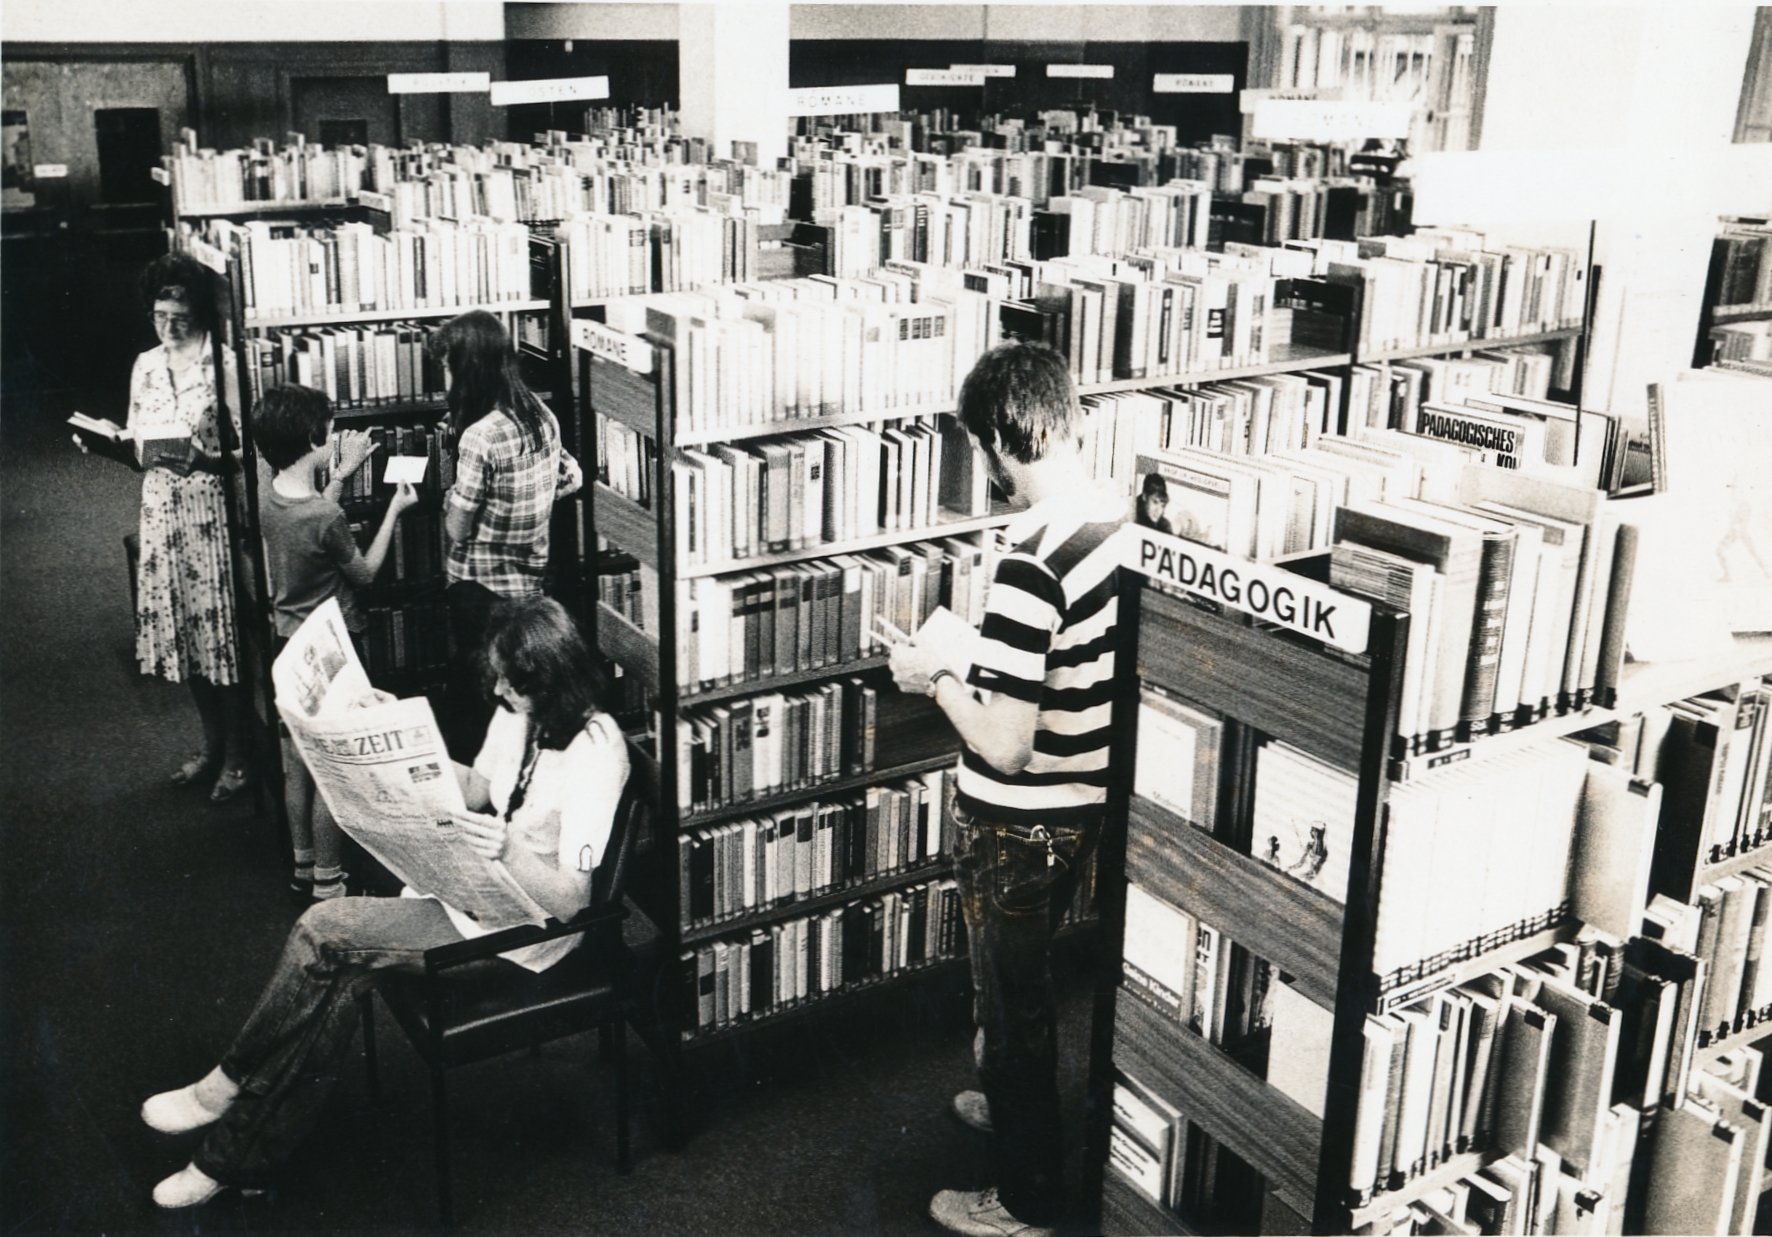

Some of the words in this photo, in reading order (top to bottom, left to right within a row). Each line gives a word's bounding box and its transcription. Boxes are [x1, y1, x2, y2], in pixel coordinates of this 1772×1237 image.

[796, 92, 865, 108] ROMANE
[583, 328, 627, 362] ROMANE
[1139, 538, 1338, 640] PÄDAGOGIK
[354, 729, 405, 757] ZEIT
